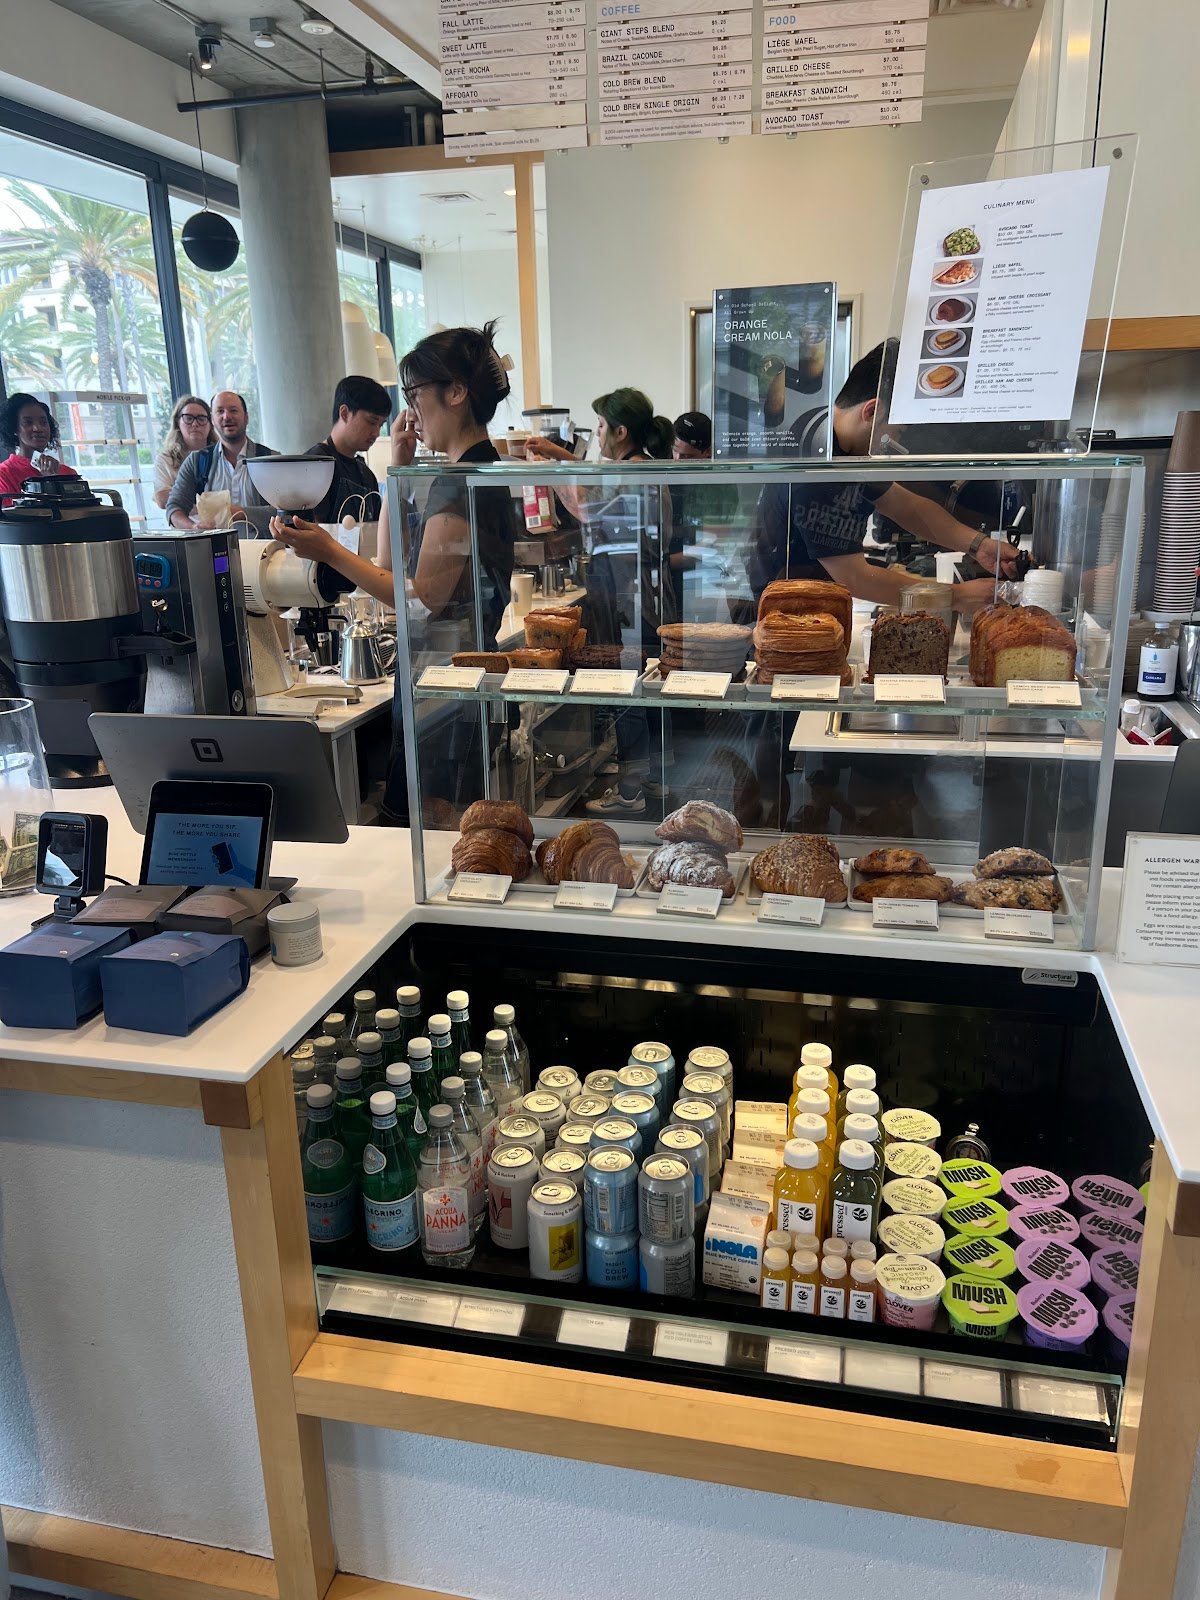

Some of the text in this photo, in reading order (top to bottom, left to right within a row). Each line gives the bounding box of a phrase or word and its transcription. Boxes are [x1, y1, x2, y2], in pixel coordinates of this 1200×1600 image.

[602, 4, 640, 16] COFFEE
[442, 18, 484, 28] FALL LATTE
[769, 15, 796, 26] FOOD
[600, 24, 675, 38] GIANT STEPS BLEND
[442, 42, 487, 53] SWEET LATTE
[795, 37, 818, 46] WAFEL
[602, 51, 663, 63] BRAZIL CACONDE
[469, 66, 490, 74] MOCHA
[766, 65, 799, 74] GRILLED
[803, 62, 831, 71] CHEESE
[603, 76, 667, 88] COLD BREW BLEND
[446, 90, 479, 99] AFFOGATO
[766, 86, 848, 99] BREAKFAST SANDWICH
[603, 98, 700, 112] COLD BREW SINGLE ORIGIN
[765, 113, 824, 124] AVOCADO TOAST
[983, 198, 1036, 210] CULINARY MENU
[724, 320, 768, 330] ORANGE
[724, 330, 792, 342] CREAM NOLA
[1040, 972, 1072, 980] Structural
[890, 1115, 914, 1123] CLOVER
[942, 1165, 992, 1184] MUSH
[906, 1183, 934, 1194] CLOVER
[1010, 1174, 1061, 1196] MUSH
[1079, 1179, 1134, 1208] MUSH
[435, 1207, 458, 1216] ACQUA
[947, 1201, 998, 1225] MUSH
[426, 1212, 467, 1229] PANNA
[781, 1202, 790, 1234] ressed
[1019, 1209, 1072, 1230] MUSH
[908, 1220, 934, 1236] CLOVER
[1086, 1214, 1143, 1244] MUSH
[712, 1238, 758, 1260] NOLA
[948, 1238, 1000, 1265] MUSH
[718, 1253, 737, 1262] BOTTLE
[1028, 1241, 1073, 1280] MUSH
[900, 1284, 930, 1292] CLOVER
[952, 1282, 1008, 1305] MUSH
[884, 1298, 914, 1314] CLOVER
[1030, 1288, 1077, 1328] MUSH
[965, 1323, 997, 1336] MUSH
